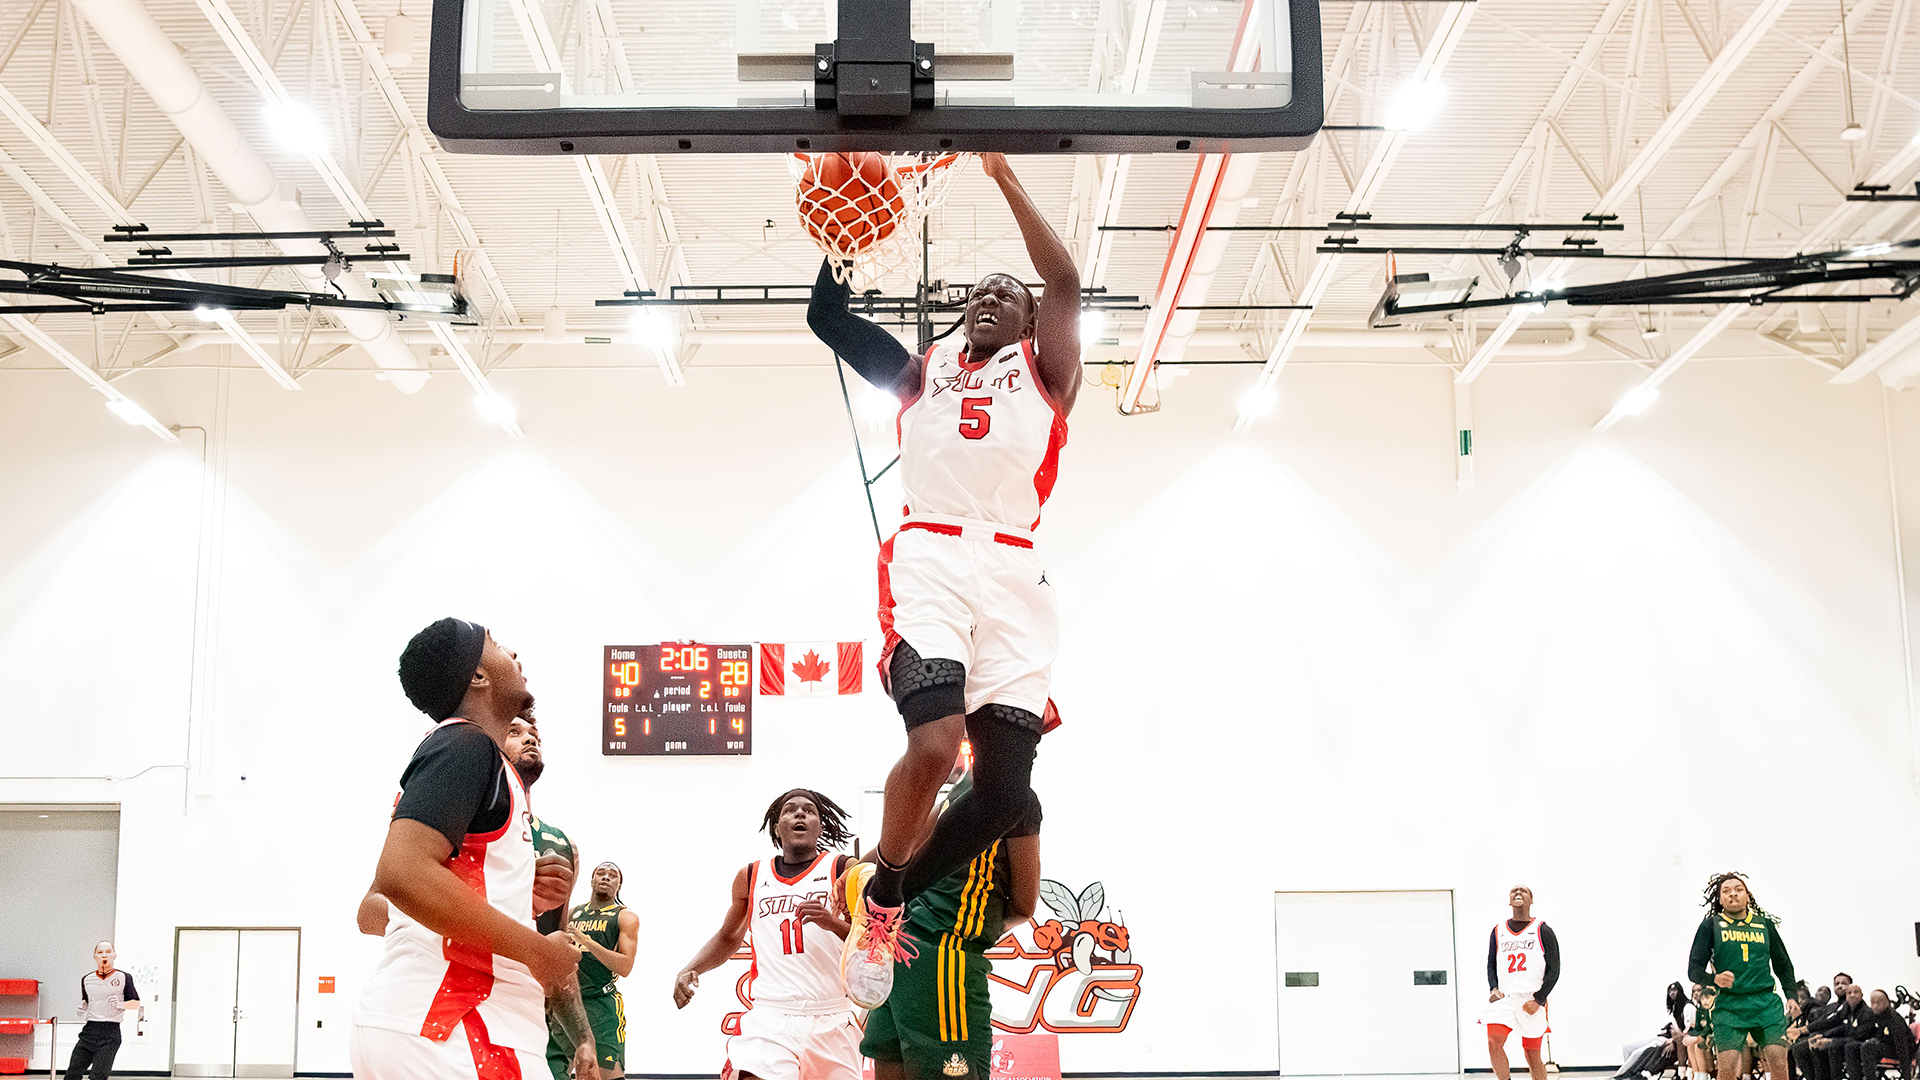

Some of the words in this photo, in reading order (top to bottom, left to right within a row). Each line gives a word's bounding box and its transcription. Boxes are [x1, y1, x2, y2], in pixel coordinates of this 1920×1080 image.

[959, 396, 993, 440] 5
[611, 649, 635, 660] Home
[660, 647, 709, 671] 2:06
[717, 648, 748, 660] Guests
[611, 662, 640, 685] 40
[719, 661, 749, 685] 28
[663, 685, 691, 698] period
[699, 681, 711, 698] 2
[608, 703, 629, 713] fouls
[662, 702, 691, 714] player
[725, 702, 746, 712] fouls
[614, 717, 626, 736] 5
[644, 718, 651, 736] 1
[709, 718, 716, 735] 1
[731, 718, 744, 735] 4
[609, 741, 627, 750] won
[664, 741, 687, 751] game
[726, 741, 744, 750] won
[780, 918, 804, 955] 11
[1721, 930, 1765, 944] DURHAM
[1740, 943, 1749, 962] 1
[1507, 952, 1527, 973] 22
